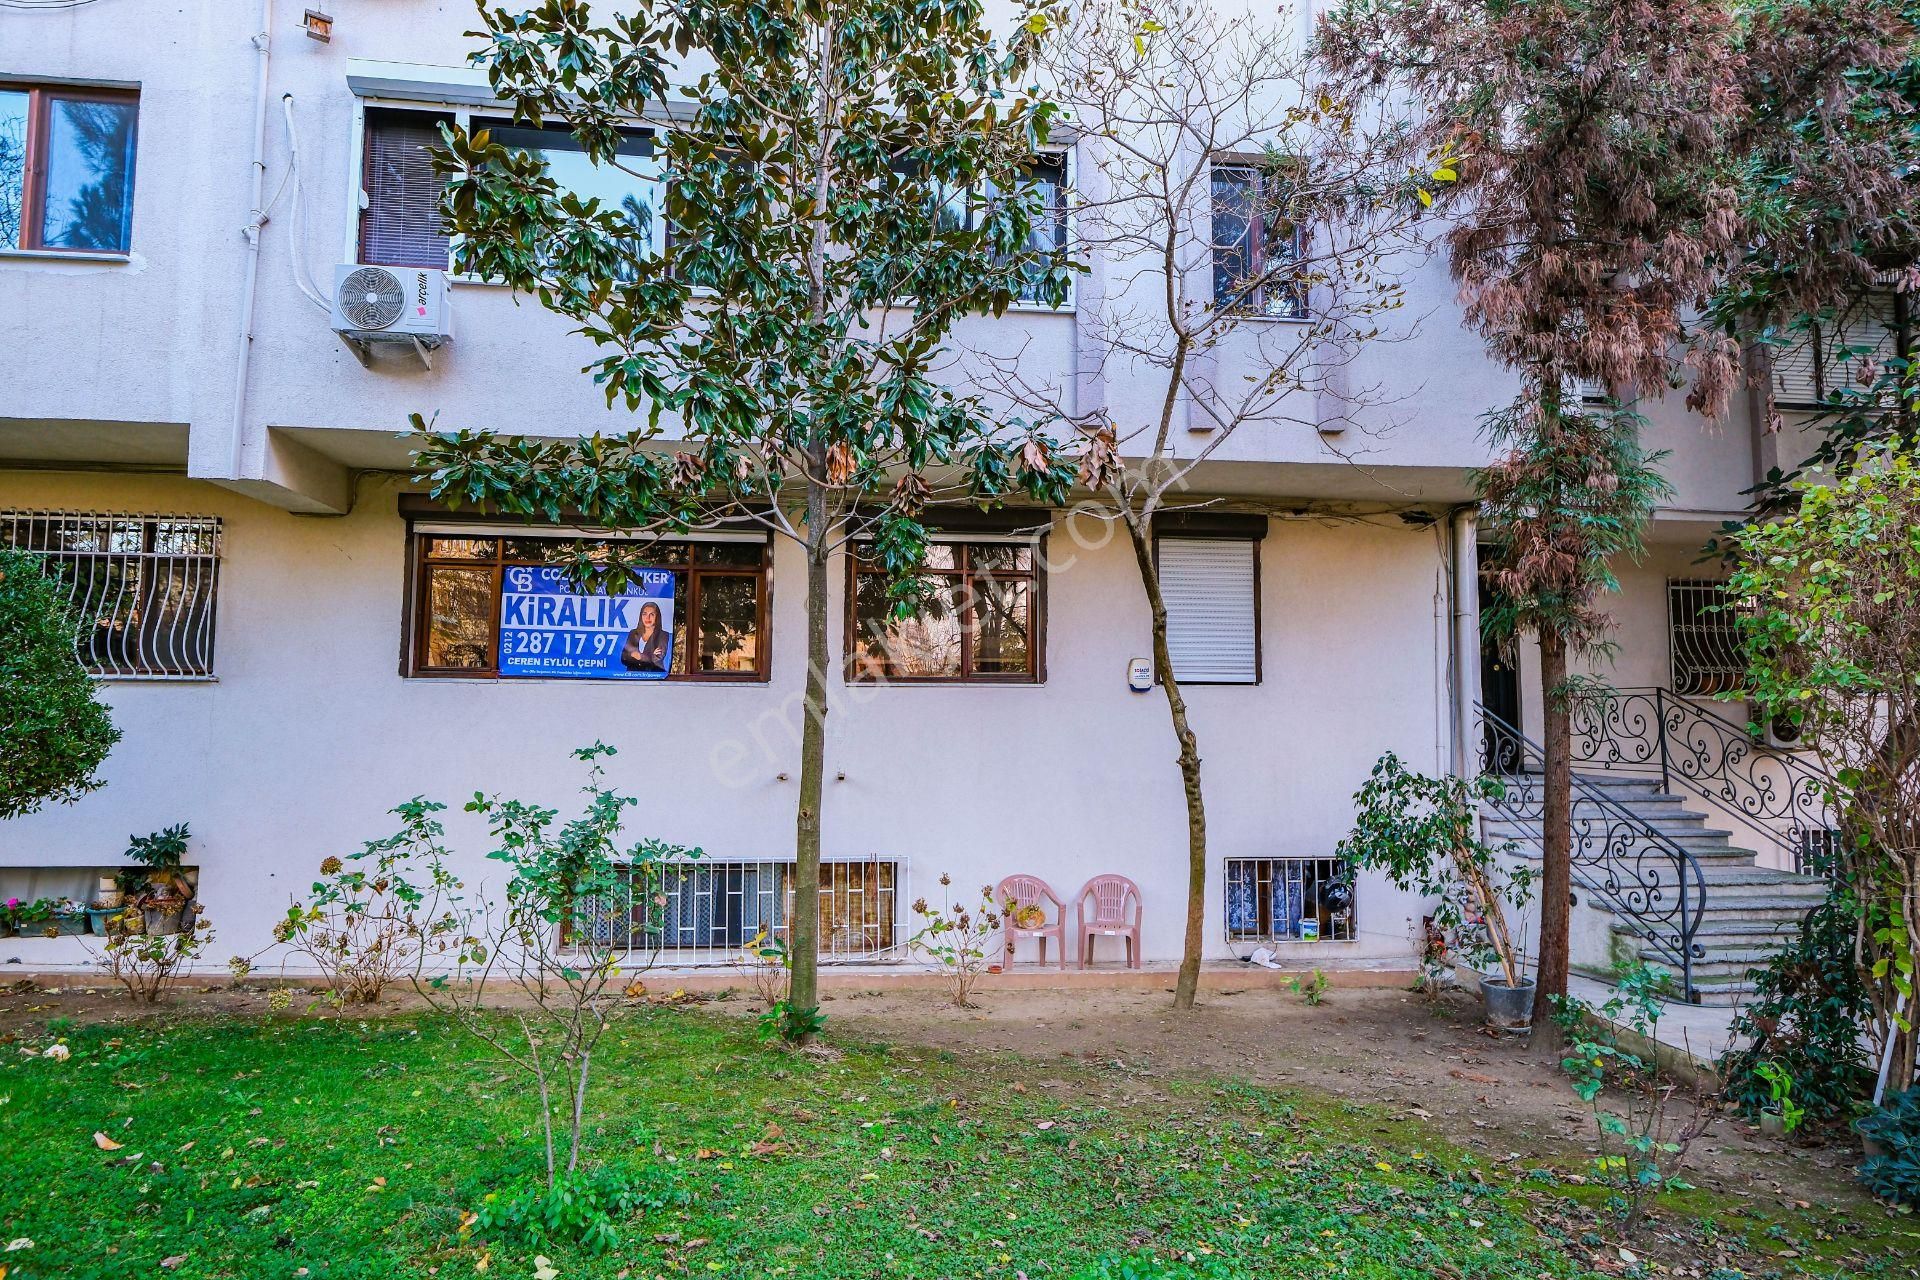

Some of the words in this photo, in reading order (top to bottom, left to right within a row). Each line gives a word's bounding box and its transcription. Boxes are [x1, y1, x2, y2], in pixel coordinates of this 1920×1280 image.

[417, 271, 429, 305] arçelik
[503, 632, 513, 654] 0212
[516, 632, 555, 654] 287
[563, 633, 586, 654] 17
[593, 634, 619, 655] 97
[507, 657, 541, 666] CEREN
[543, 656, 575, 667] EYLÜL
[577, 658, 607, 669] ÇEPNİ
